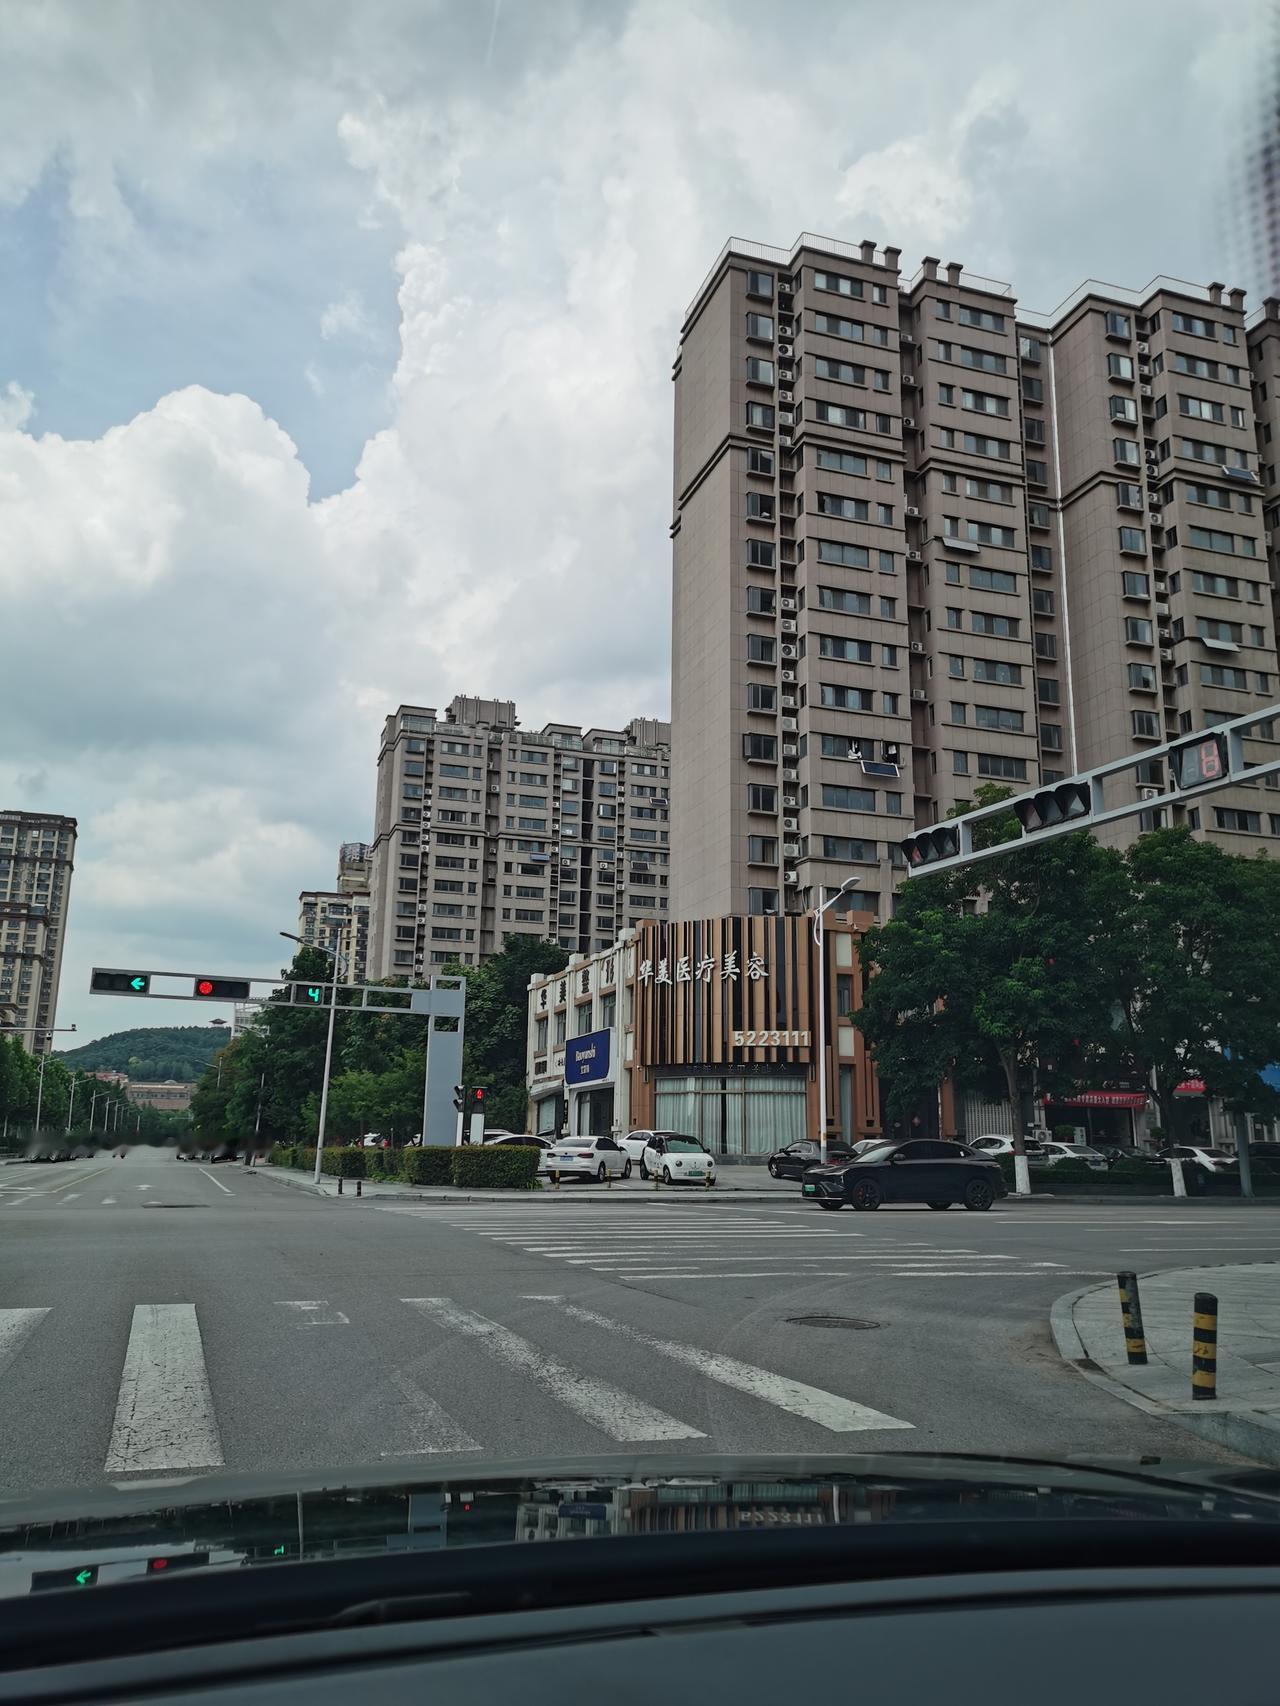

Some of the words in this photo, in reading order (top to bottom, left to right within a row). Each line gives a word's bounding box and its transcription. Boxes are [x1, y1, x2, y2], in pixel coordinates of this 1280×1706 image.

[637, 949, 769, 988] 华美医疗美容
[308, 987, 320, 1002] 4
[733, 1030, 809, 1047] 5223111
